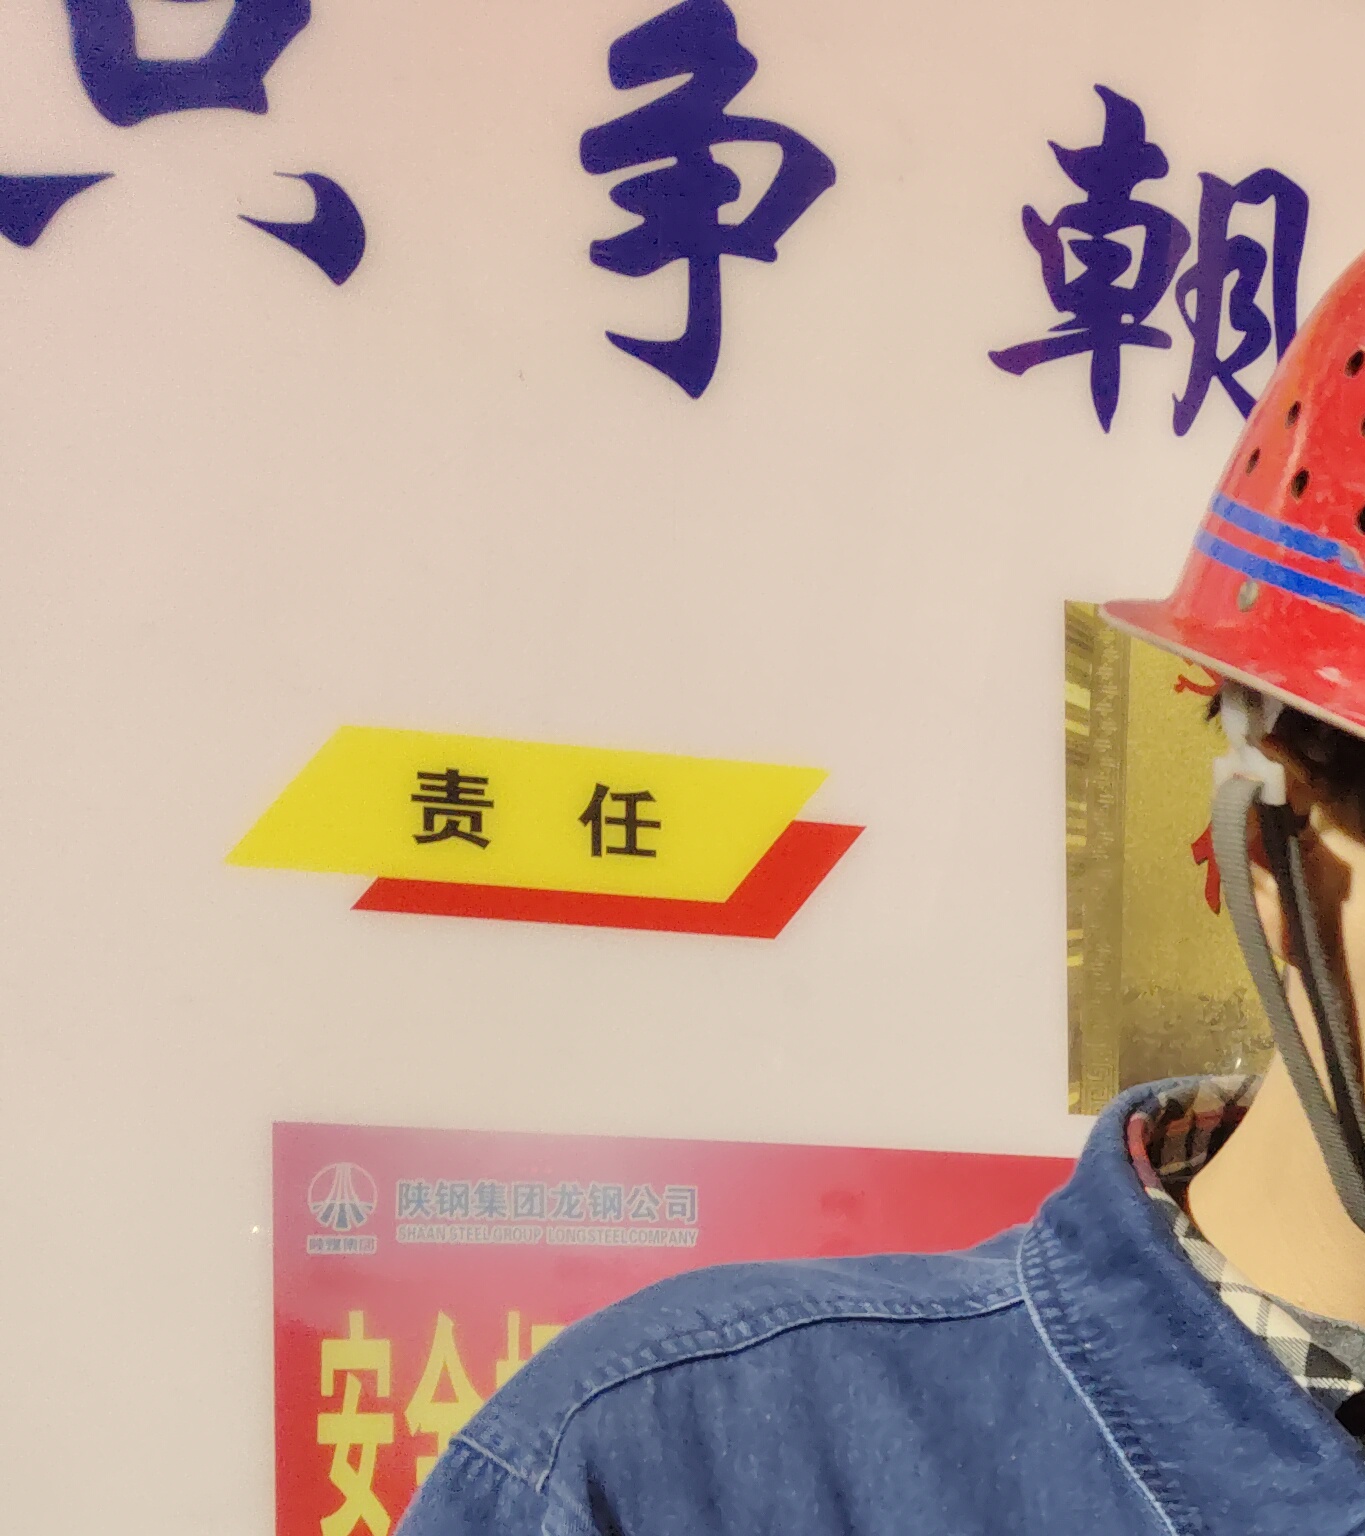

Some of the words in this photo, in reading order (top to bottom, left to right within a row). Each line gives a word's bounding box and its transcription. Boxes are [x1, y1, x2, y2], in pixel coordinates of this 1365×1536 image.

[410, 767, 664, 858] 责任
[397, 1180, 698, 1222] 陕钢集团龙钢公司
